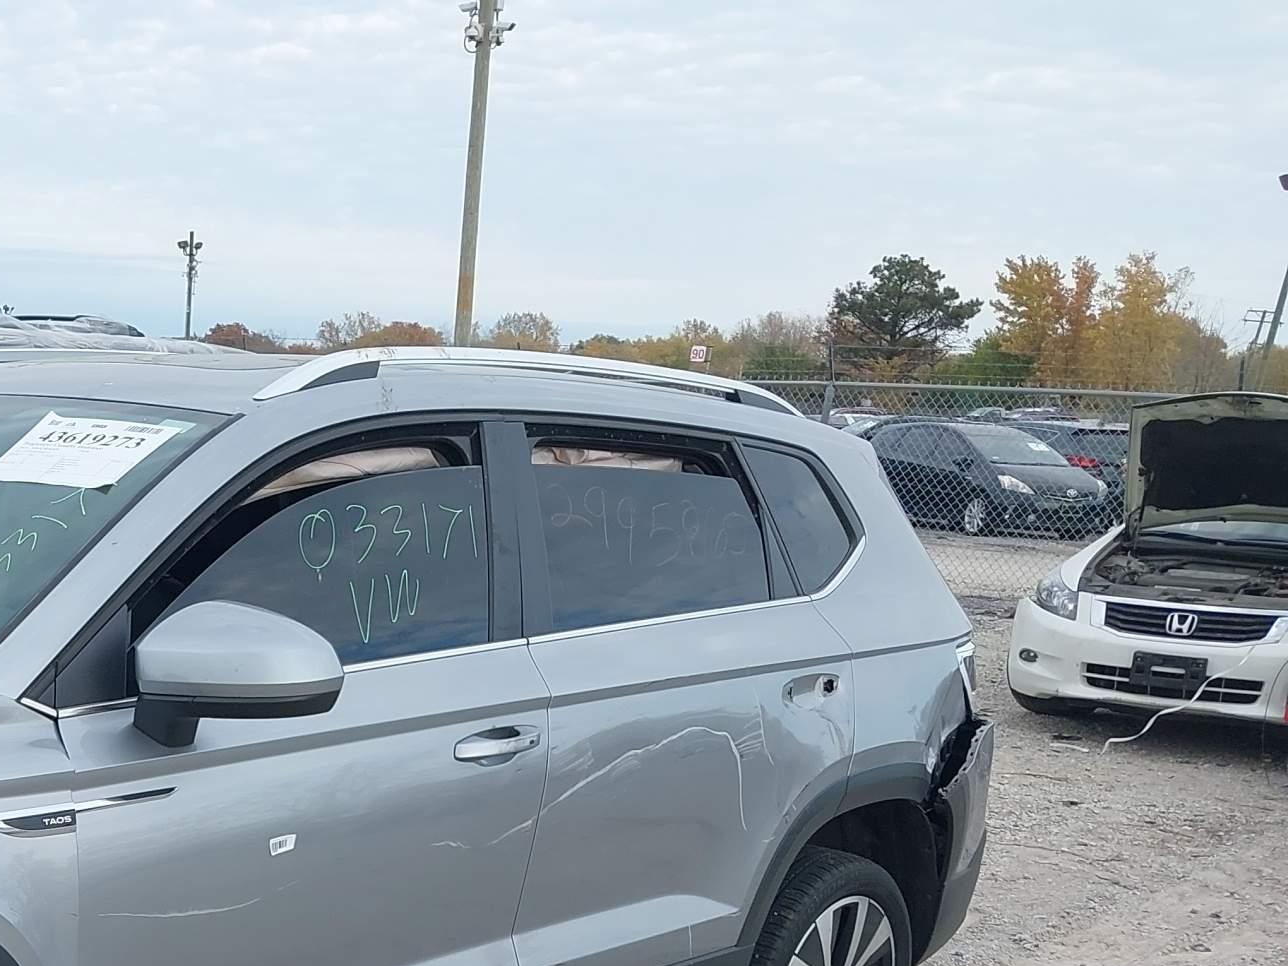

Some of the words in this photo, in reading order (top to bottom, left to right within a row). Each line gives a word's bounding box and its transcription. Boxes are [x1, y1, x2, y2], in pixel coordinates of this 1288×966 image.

[692, 348, 705, 360] 90
[38, 430, 147, 449] 43619273
[299, 503, 478, 569] 033171
[349, 569, 420, 644] VW
[42, 815, 73, 826] TAOS
